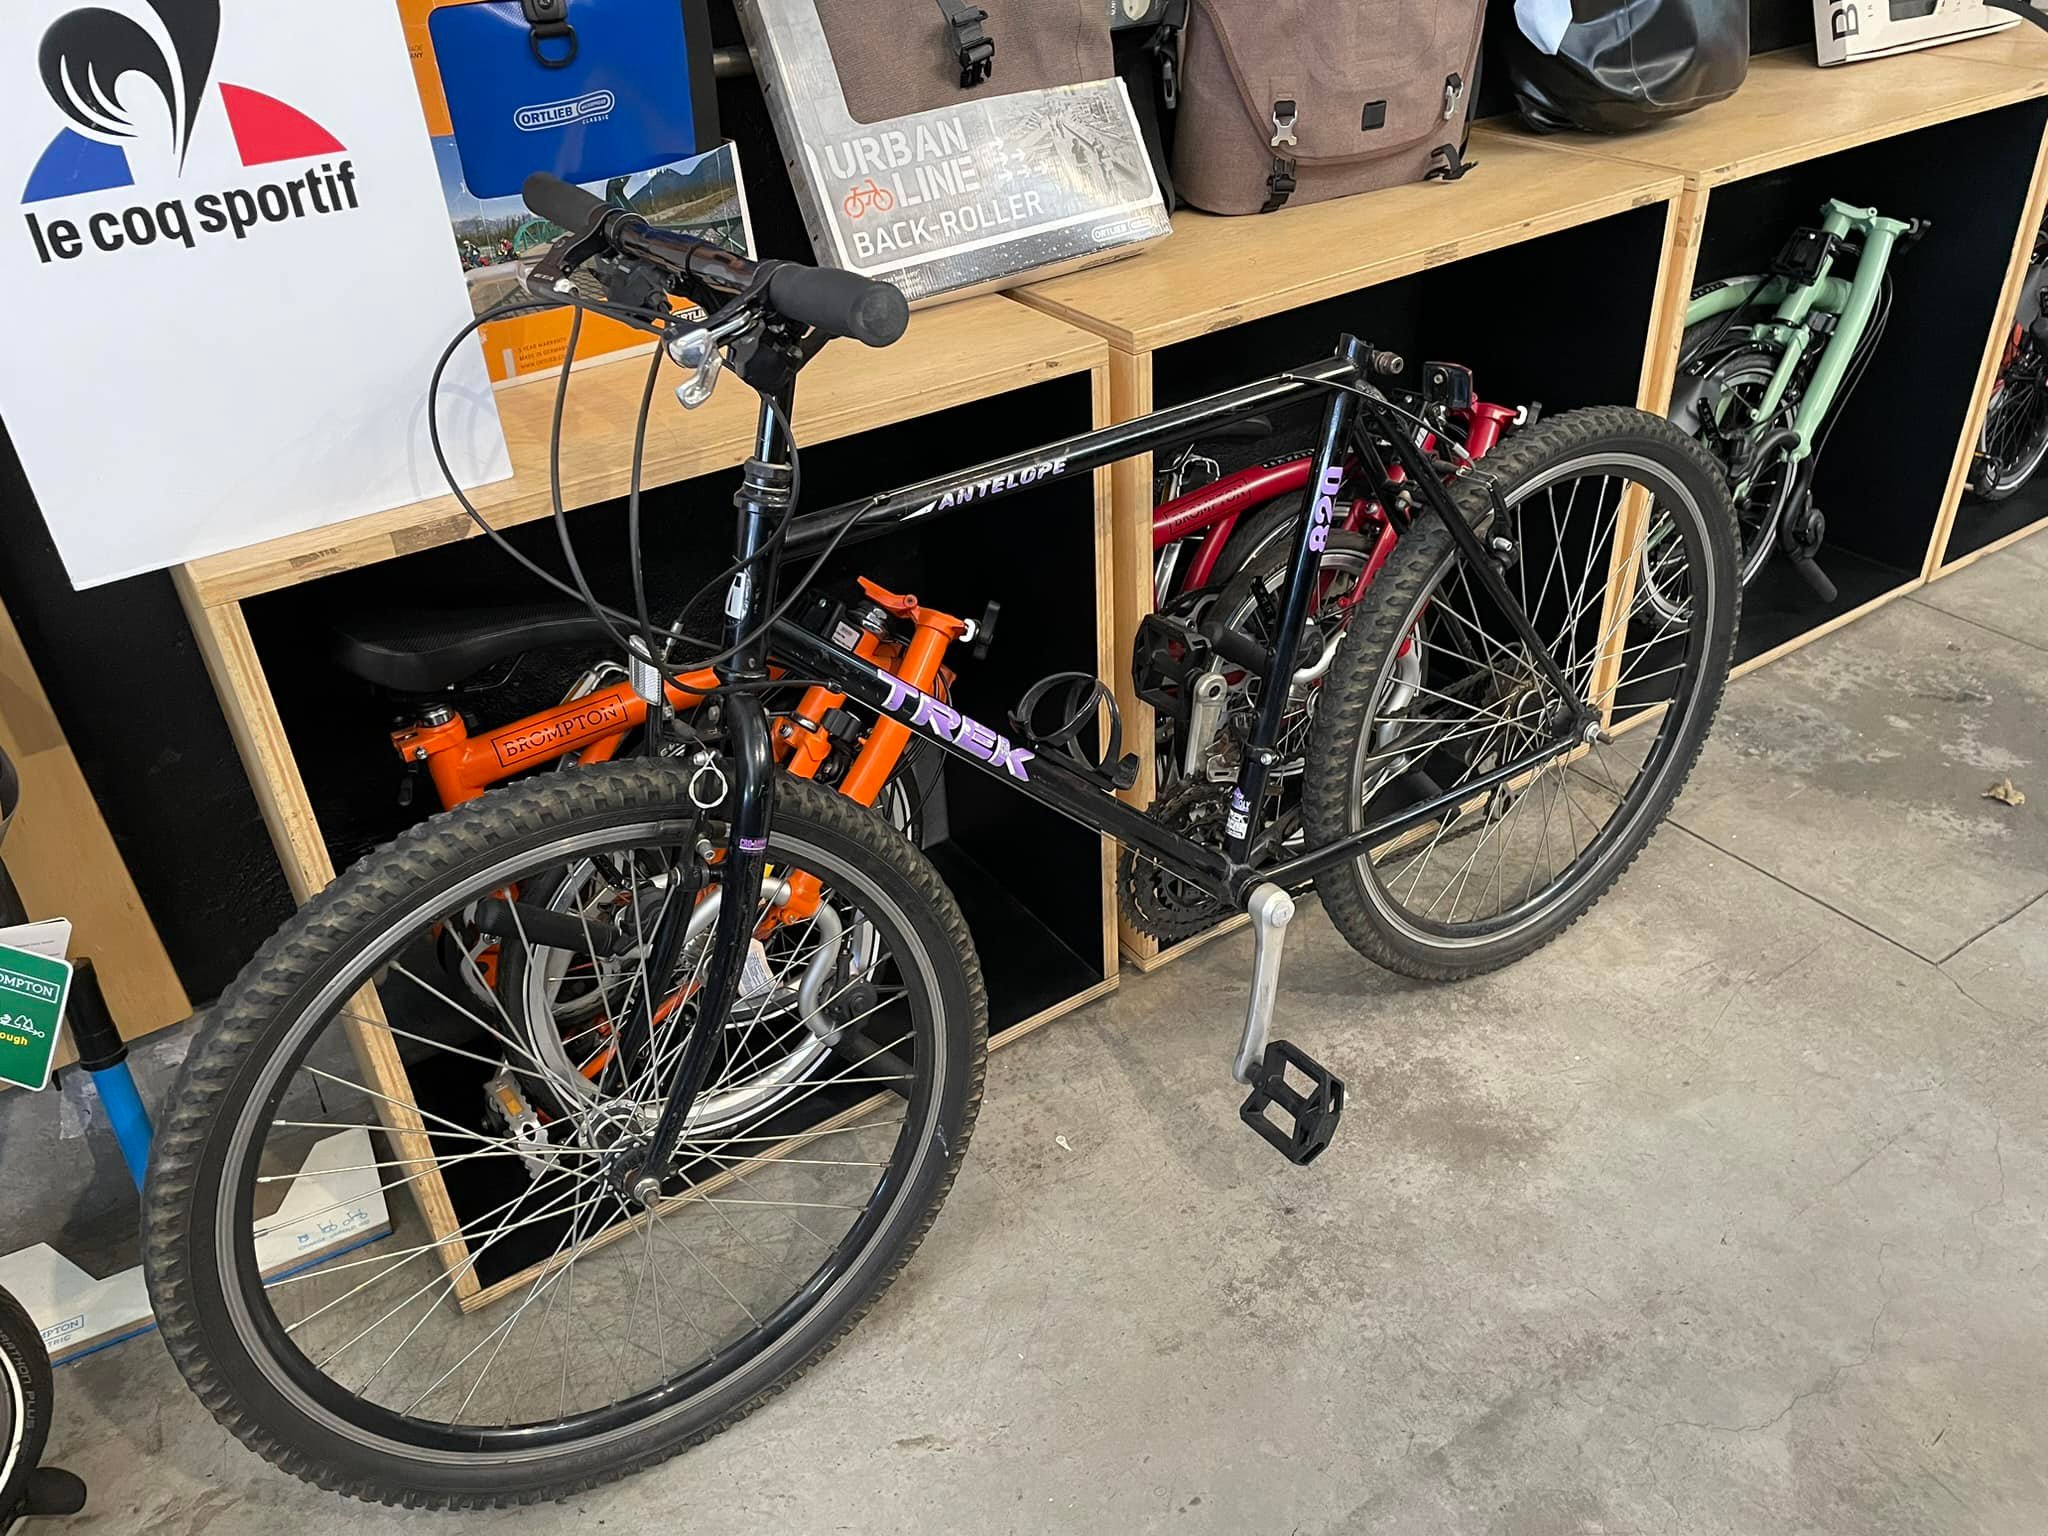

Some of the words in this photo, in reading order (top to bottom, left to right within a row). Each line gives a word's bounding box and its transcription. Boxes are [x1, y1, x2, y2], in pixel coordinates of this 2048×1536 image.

[1831, 0, 1859, 40] B
[521, 105, 573, 124] ORTLIEB
[824, 117, 969, 180] URBAN
[893, 155, 981, 207] LINE
[25, 211, 83, 264] le
[88, 199, 196, 249] coq
[191, 160, 360, 239] sportif
[853, 190, 1044, 259] BACK-ROLLER
[938, 456, 1068, 511] ANTELOPE
[1309, 466, 1344, 553] 820
[503, 703, 618, 758] BROMPTON
[877, 668, 1036, 783] TREK
